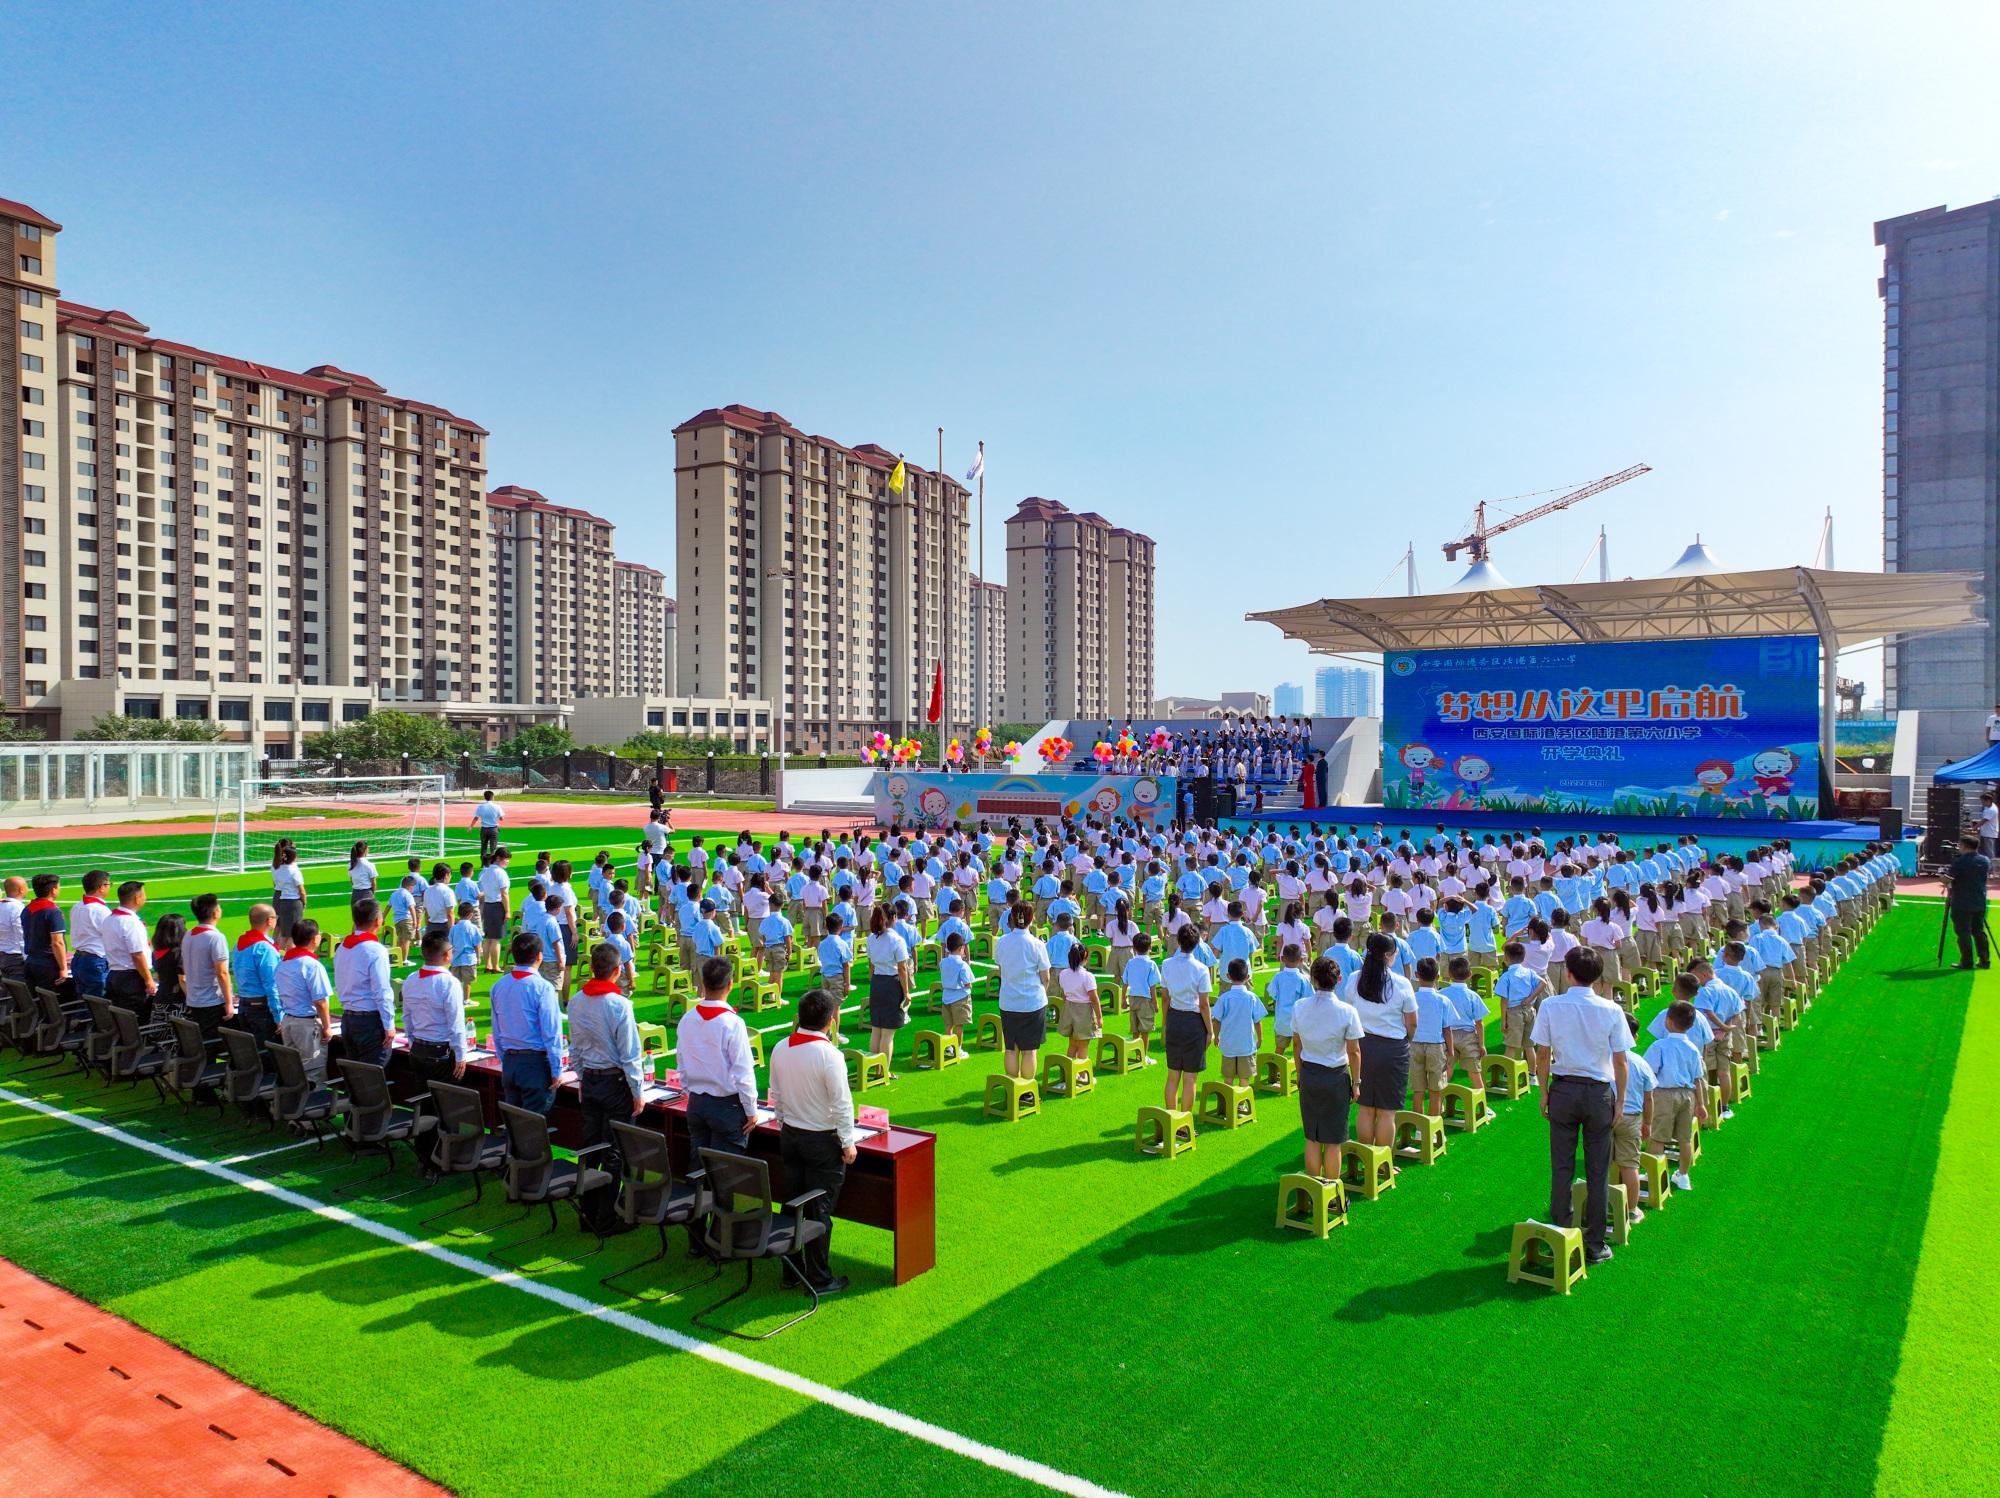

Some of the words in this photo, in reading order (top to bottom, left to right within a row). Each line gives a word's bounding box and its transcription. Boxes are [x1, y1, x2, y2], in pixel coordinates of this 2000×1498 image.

[1437, 685, 1748, 722] 梦想从这里启航
[1473, 726, 1702, 740] 西安国际港务区陆港第六小学
[1541, 745, 1625, 761] 开学典礼
